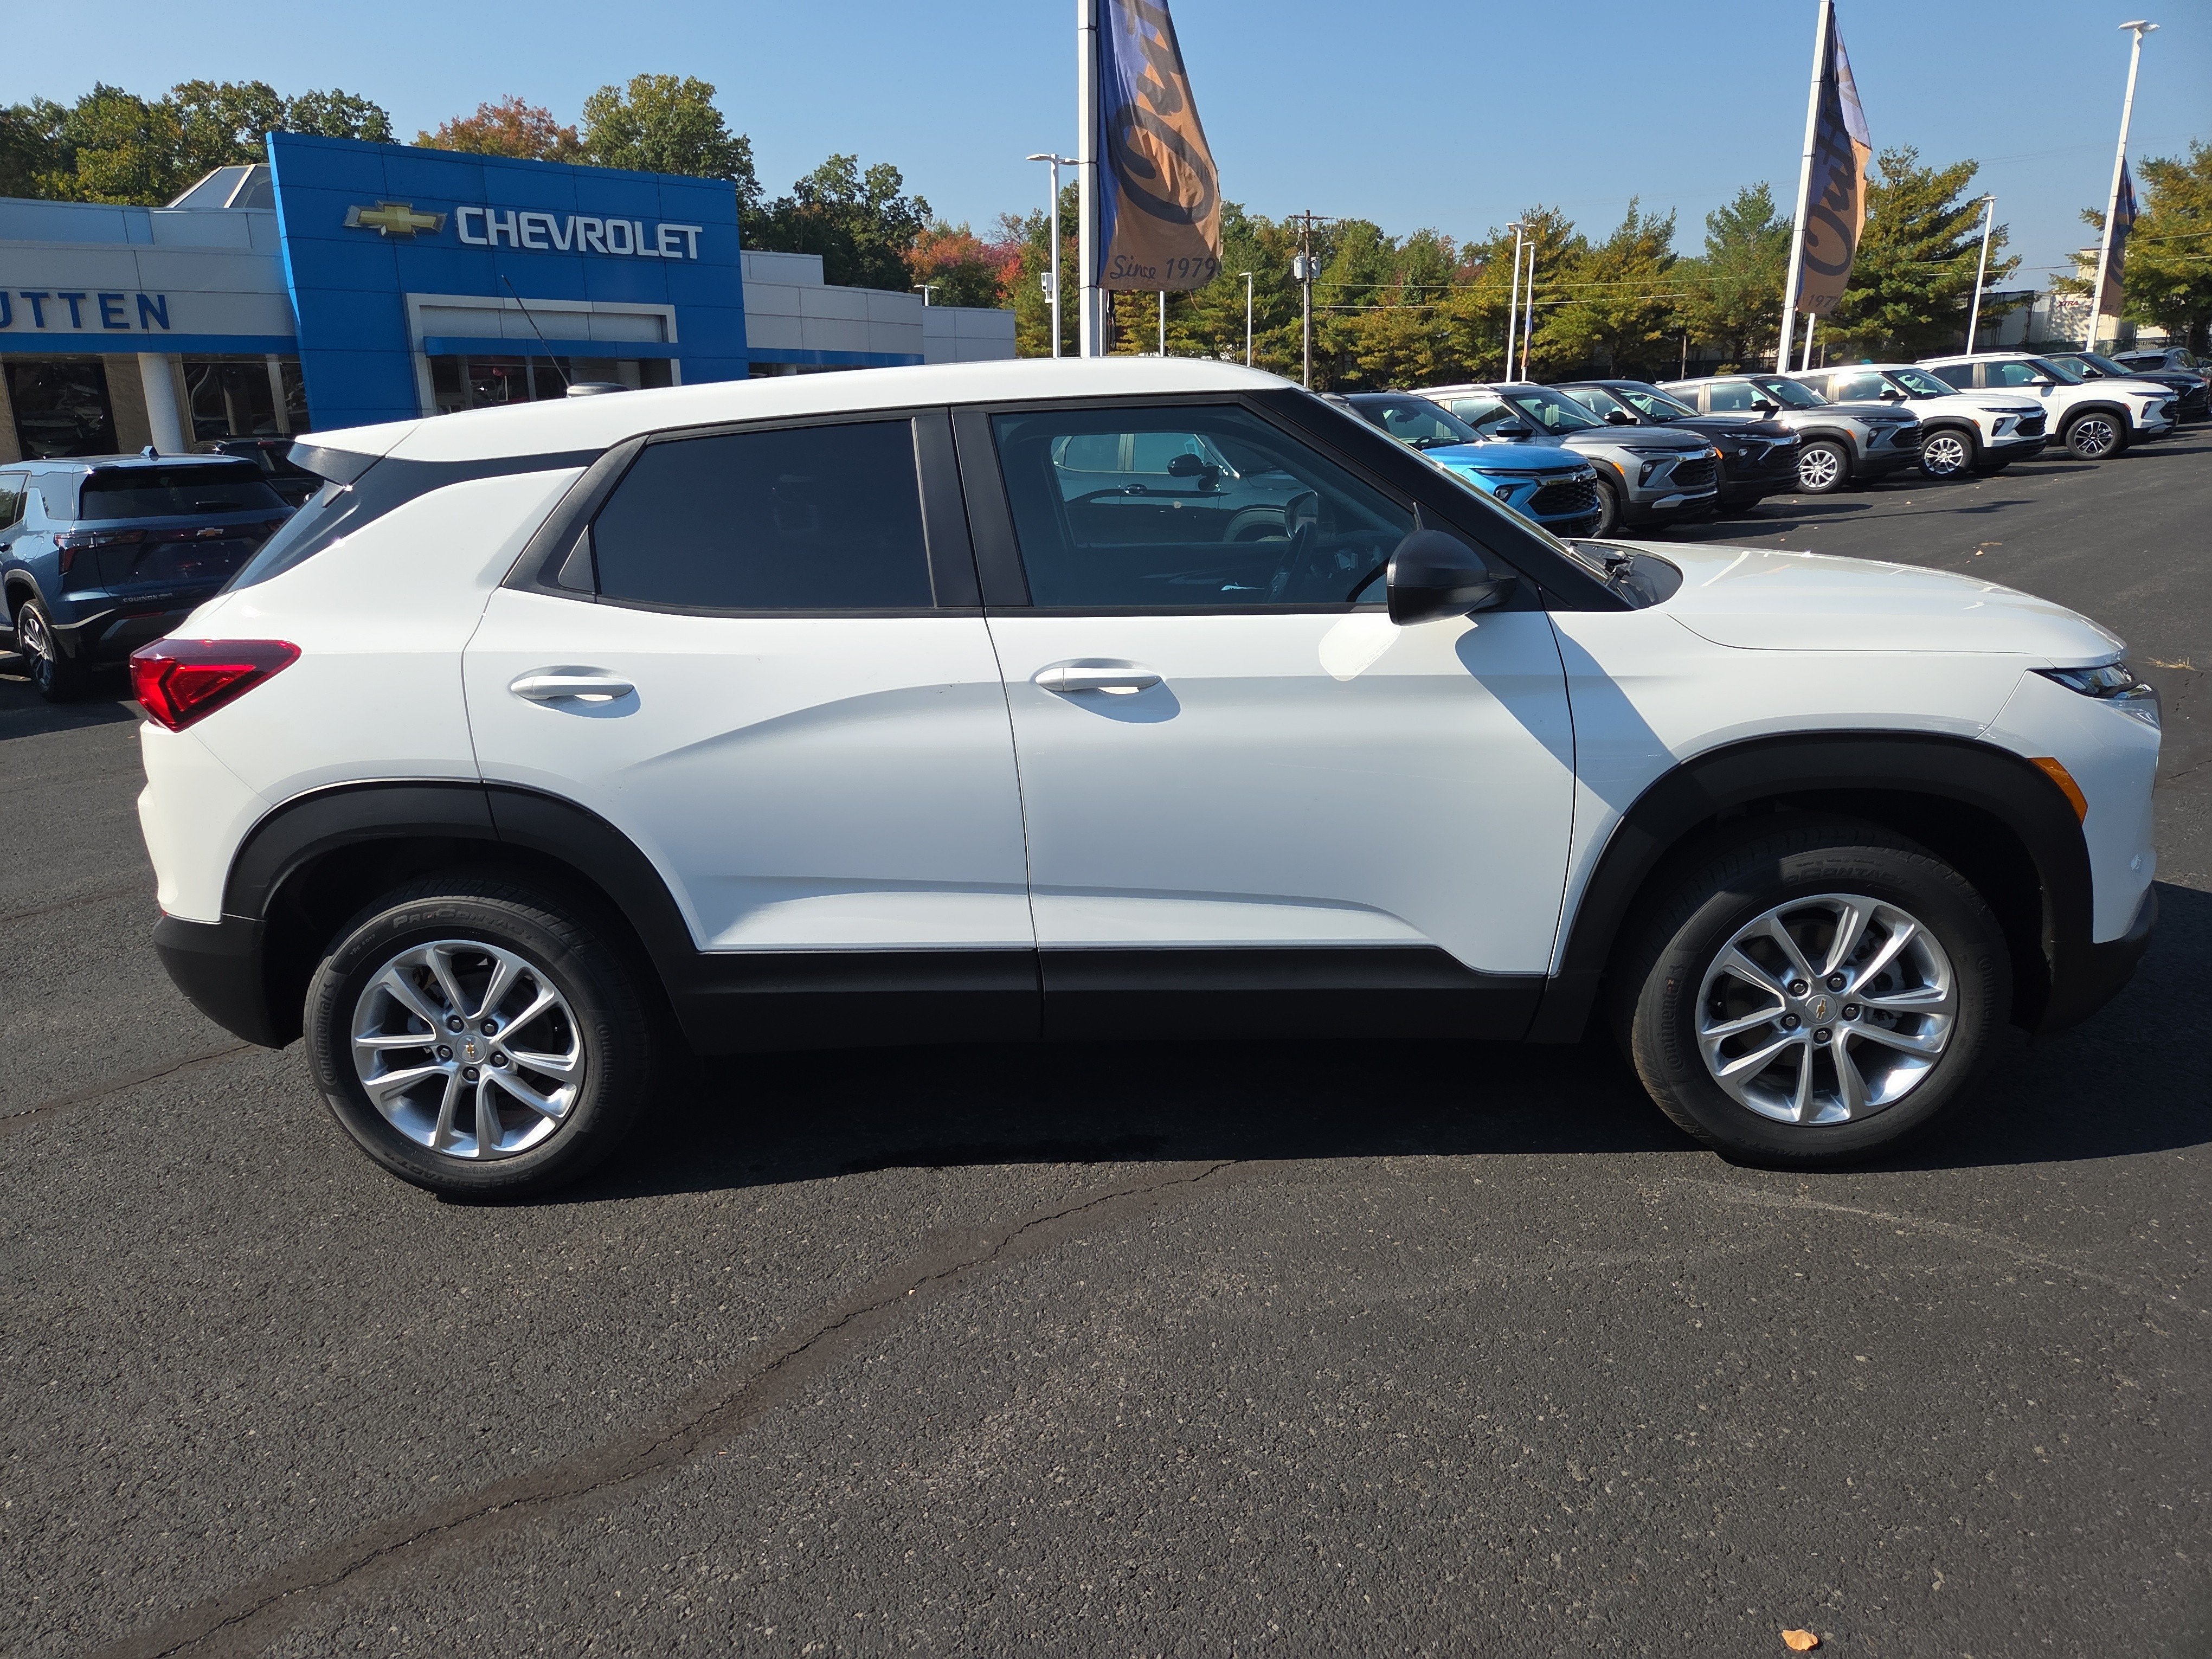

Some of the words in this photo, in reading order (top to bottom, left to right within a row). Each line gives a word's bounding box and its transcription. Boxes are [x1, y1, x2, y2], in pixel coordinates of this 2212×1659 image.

[456, 206, 703, 259] CHEVROLET
[1109, 255, 1156, 280] Since
[1166, 258, 1217, 280] 1979
[1808, 294, 1840, 308] 197
[2056, 300, 2079, 308] XTRA
[316, 993, 338, 1085] Continental
